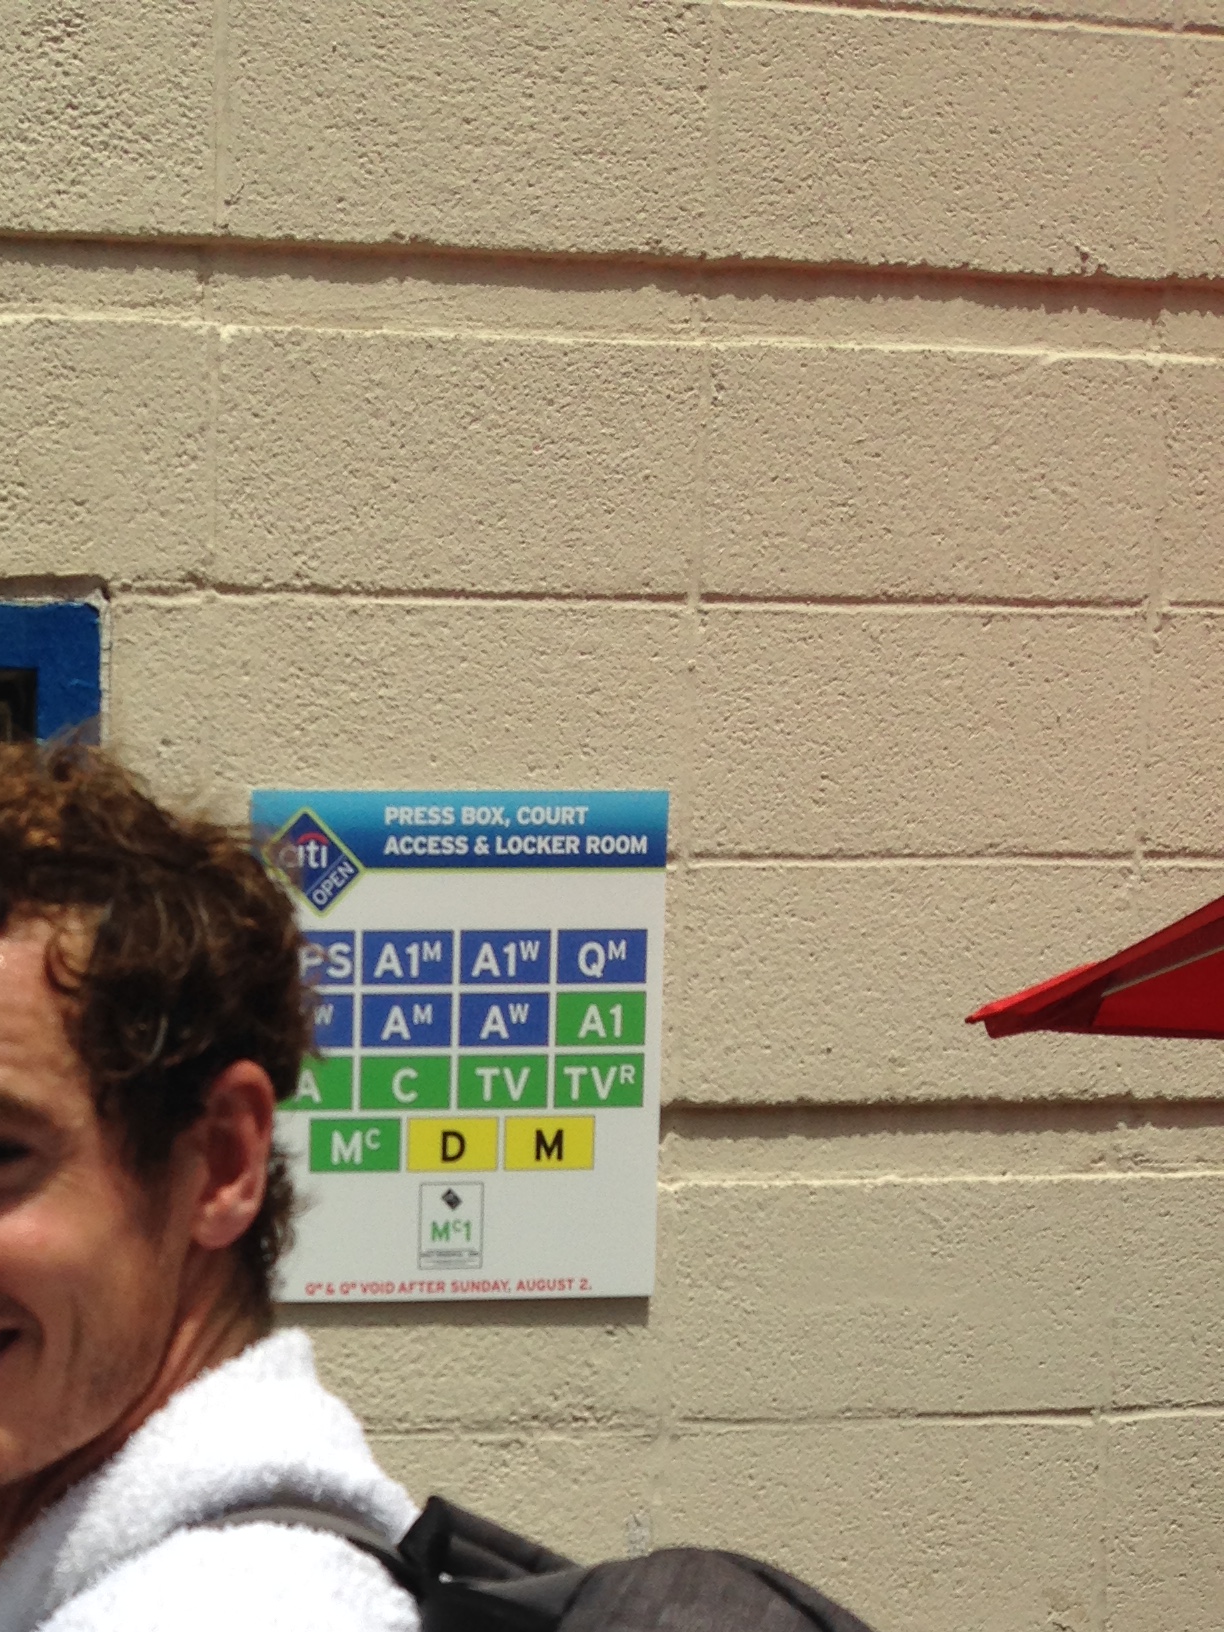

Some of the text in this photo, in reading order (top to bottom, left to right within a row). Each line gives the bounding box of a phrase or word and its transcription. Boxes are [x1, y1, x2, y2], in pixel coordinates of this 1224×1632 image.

[384, 806, 589, 828] PRESS BOX, COURT
[384, 833, 648, 856] ACCESS & LOCKER ROOM
[311, 860, 356, 906] OPEN
[578, 1004, 623, 1038] A1
[295, 1069, 322, 1103] A
[391, 1067, 419, 1103] C
[475, 1067, 531, 1101] TV
[440, 1130, 466, 1163] D
[534, 1129, 565, 1162] M
[360, 1281, 395, 1295] VOID
[397, 1280, 446, 1294] AFTER
[515, 1277, 575, 1292] AUGUST
